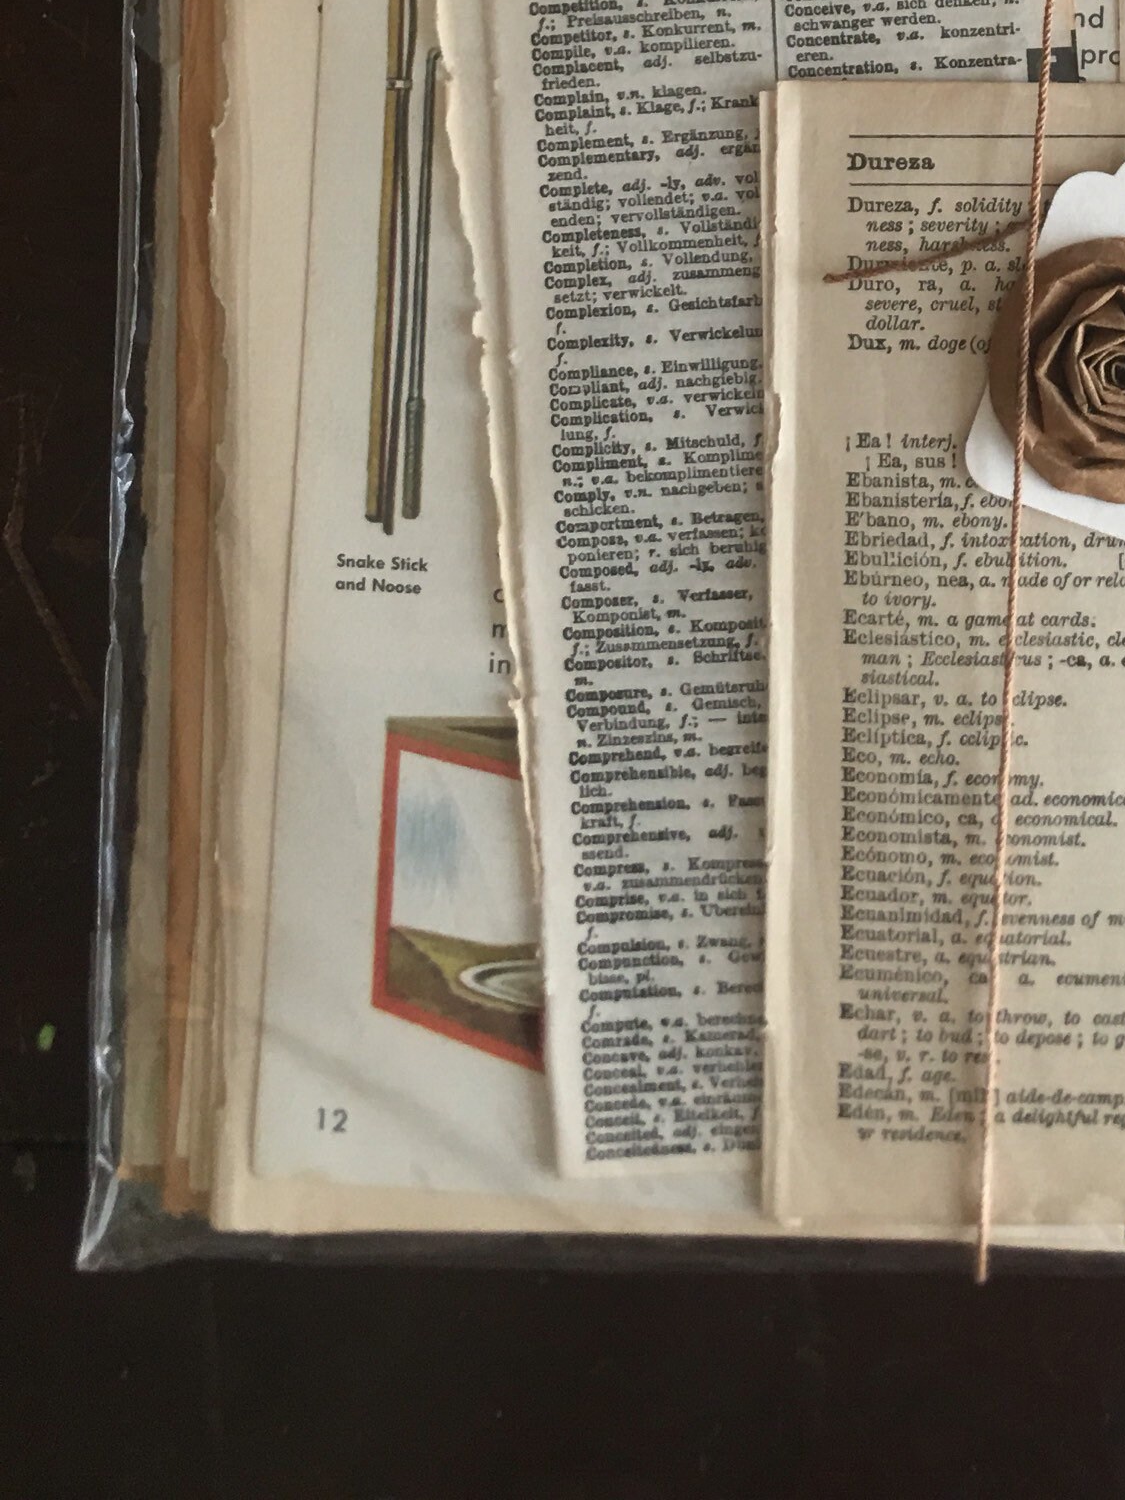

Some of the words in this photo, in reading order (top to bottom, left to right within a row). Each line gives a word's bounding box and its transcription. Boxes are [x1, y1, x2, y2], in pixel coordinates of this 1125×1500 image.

[528, 0, 625, 20] Competition,
[530, 29, 618, 49] Competitor,
[622, 29, 636, 40] s.
[641, 20, 738, 41] Konkurrent,
[740, 21, 762, 32] m.
[846, 152, 936, 171] Dureza
[846, 196, 920, 216] Dureza,
[926, 196, 943, 216] f.
[953, 196, 1024, 219] solidity
[336, 553, 386, 570] Snake
[390, 556, 429, 572] Stick
[334, 576, 367, 592] and
[371, 577, 422, 595] Noose
[840, 746, 885, 768] Eco,
[889, 752, 912, 766] m.
[918, 746, 962, 767] echo.
[317, 1106, 349, 1134] 12
